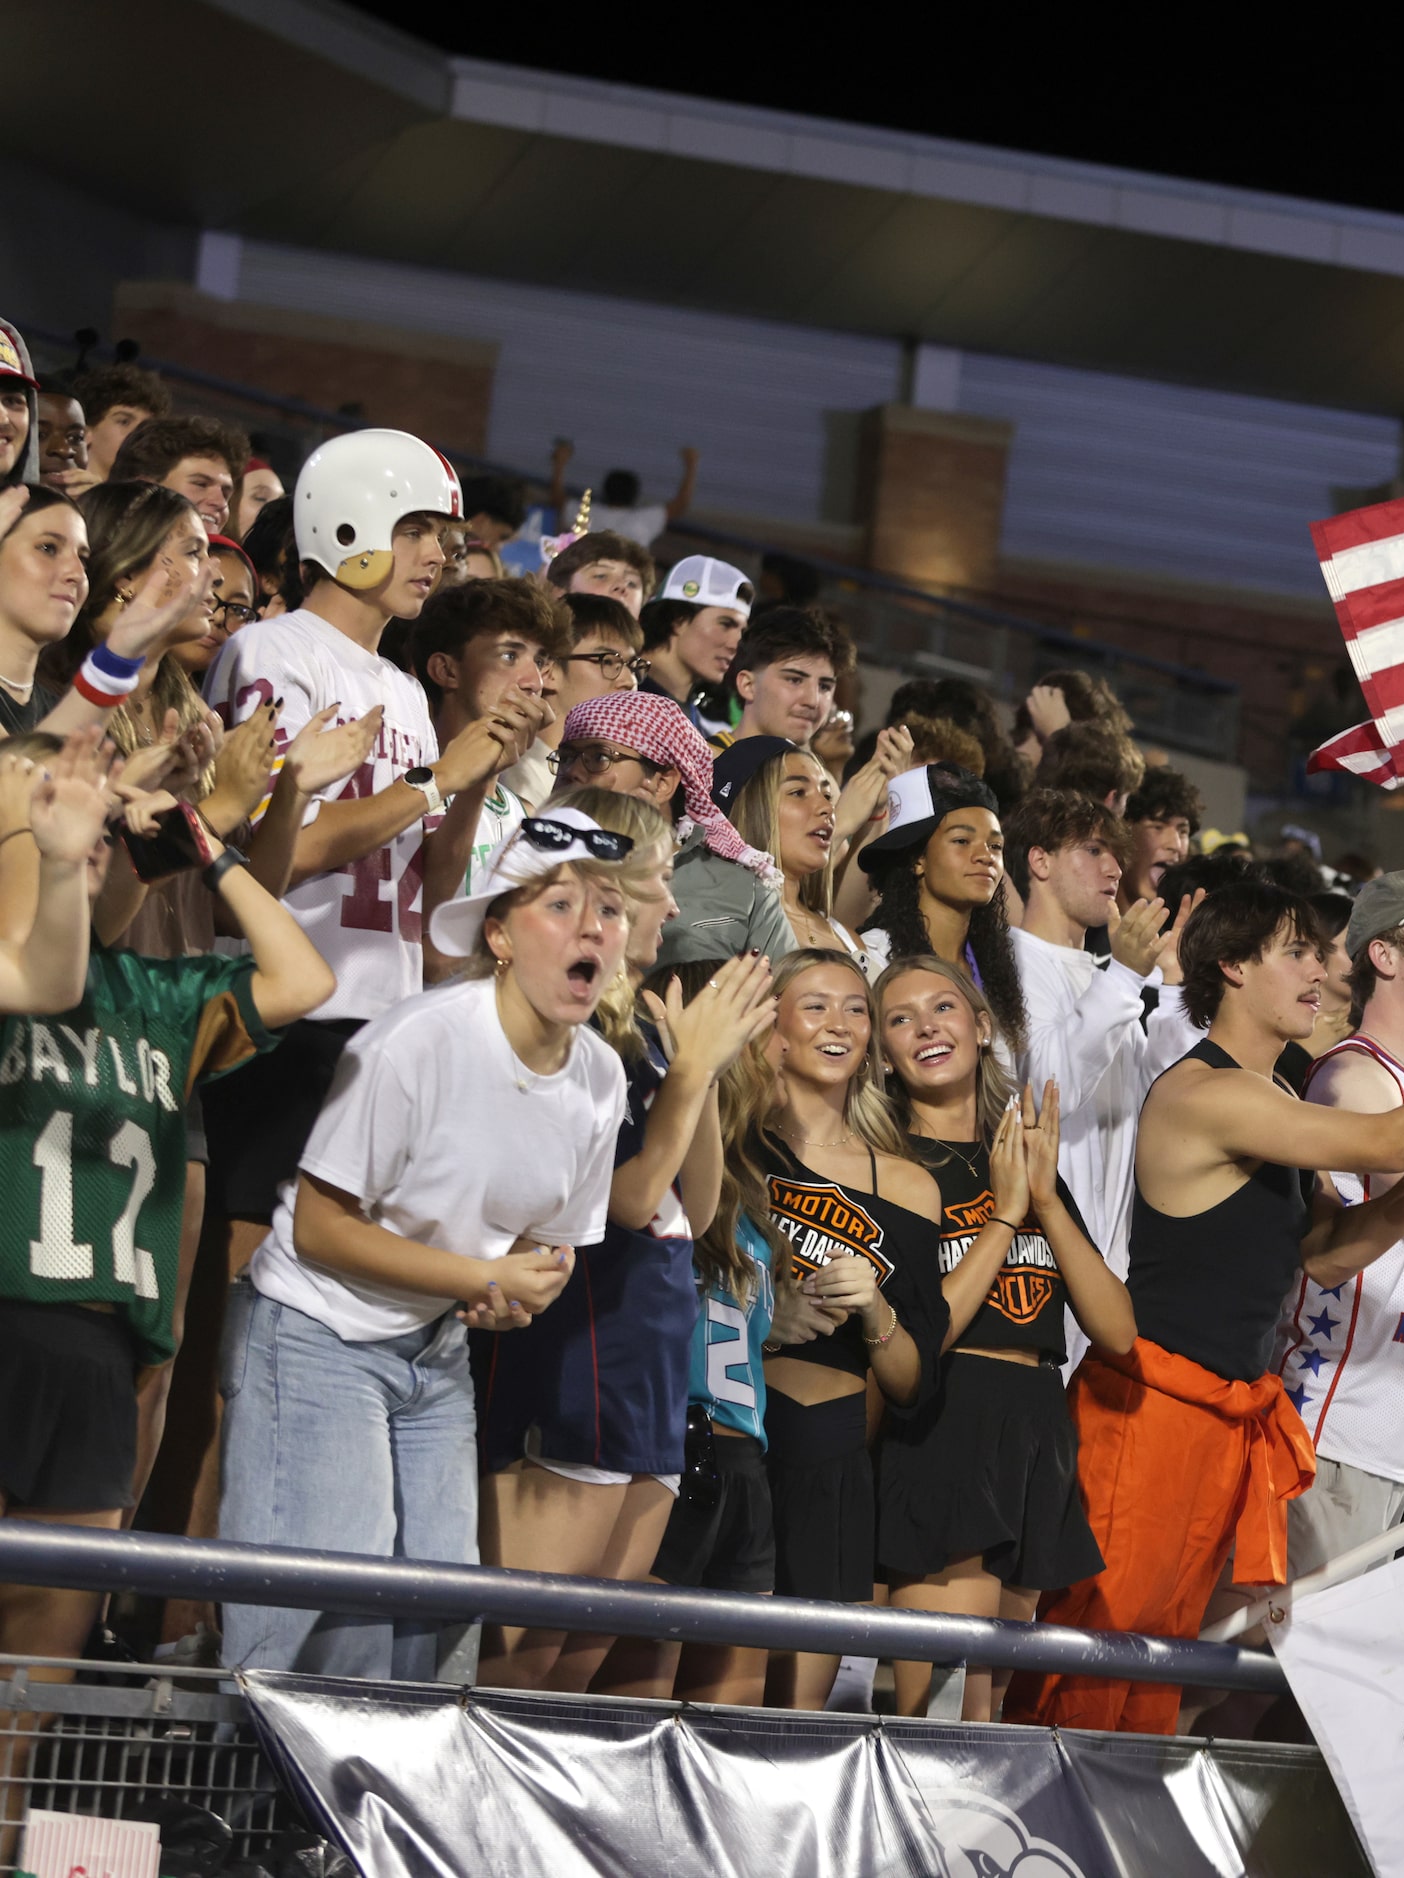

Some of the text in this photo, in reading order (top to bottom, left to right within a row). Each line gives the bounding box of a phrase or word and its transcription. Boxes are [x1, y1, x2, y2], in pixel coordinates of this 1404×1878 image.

[0, 1022, 179, 1111] BAYLOR
[30, 1110, 159, 1300] 12
[783, 1191, 865, 1239] MOTOR
